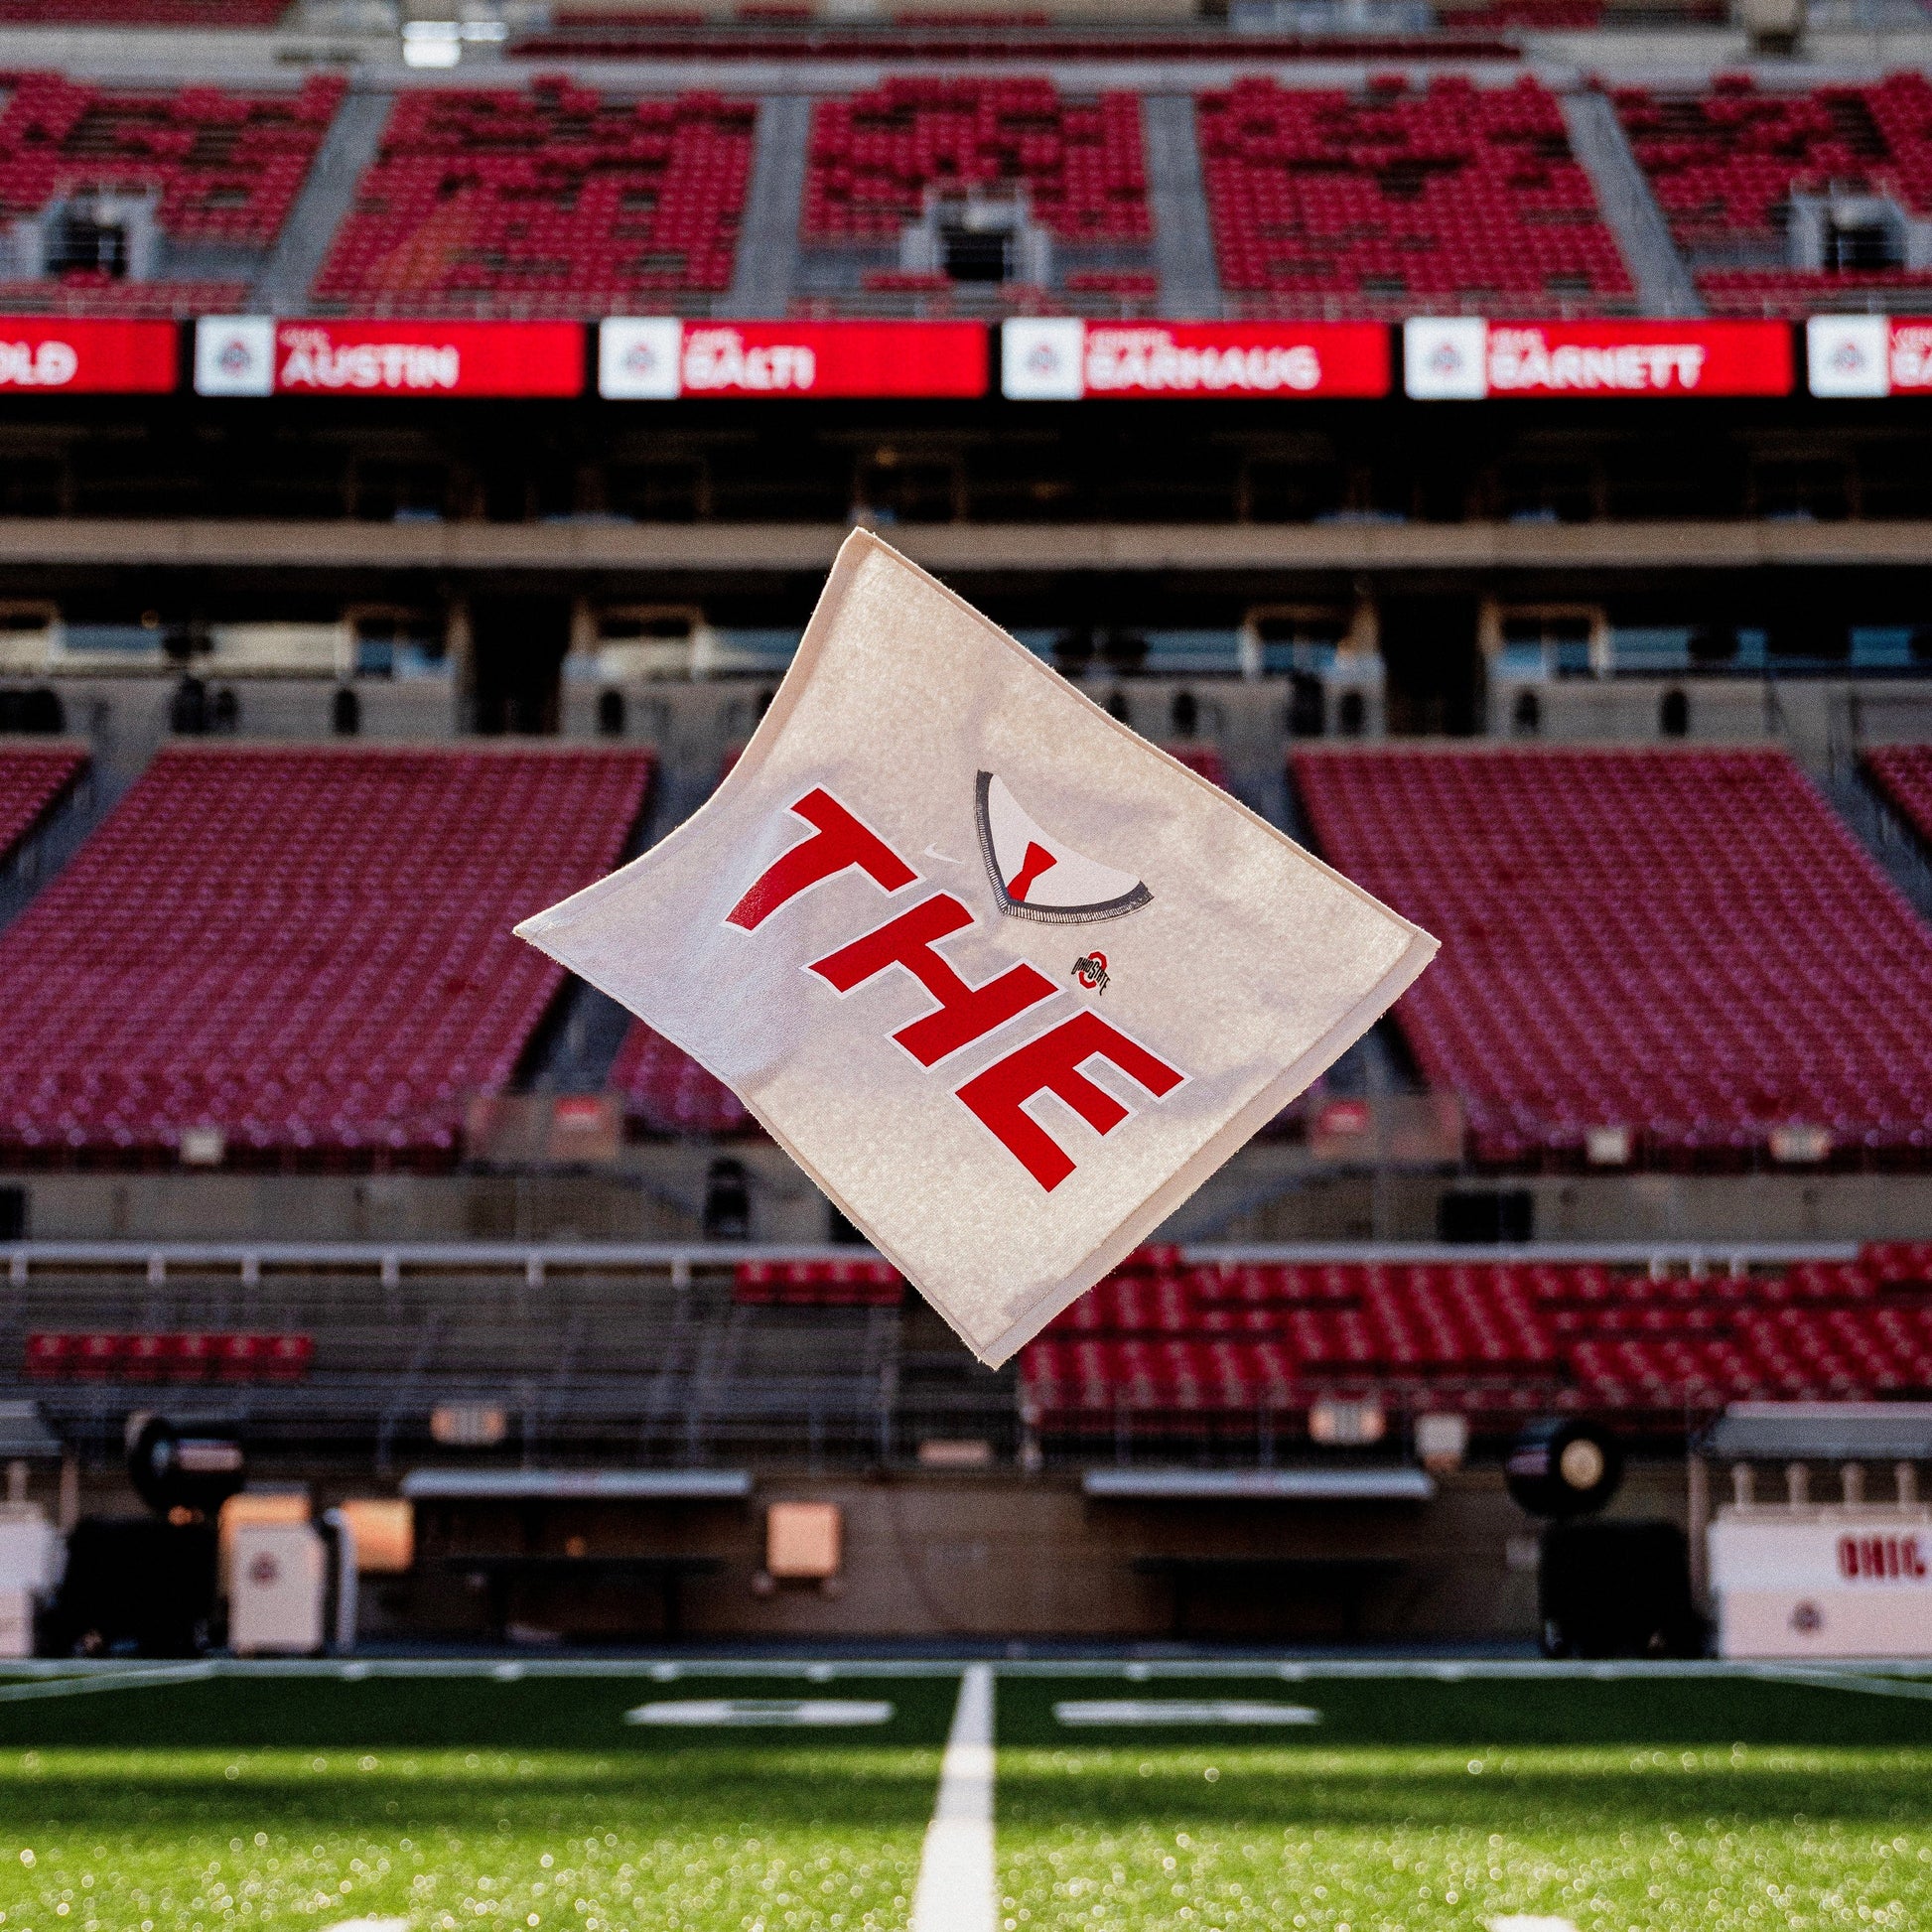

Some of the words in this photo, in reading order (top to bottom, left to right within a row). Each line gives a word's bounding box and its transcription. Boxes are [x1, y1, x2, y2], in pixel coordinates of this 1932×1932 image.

[281, 345, 460, 388] AUSTIN
[1489, 345, 1705, 389] BARNETT
[721, 781, 1193, 1194] THE
